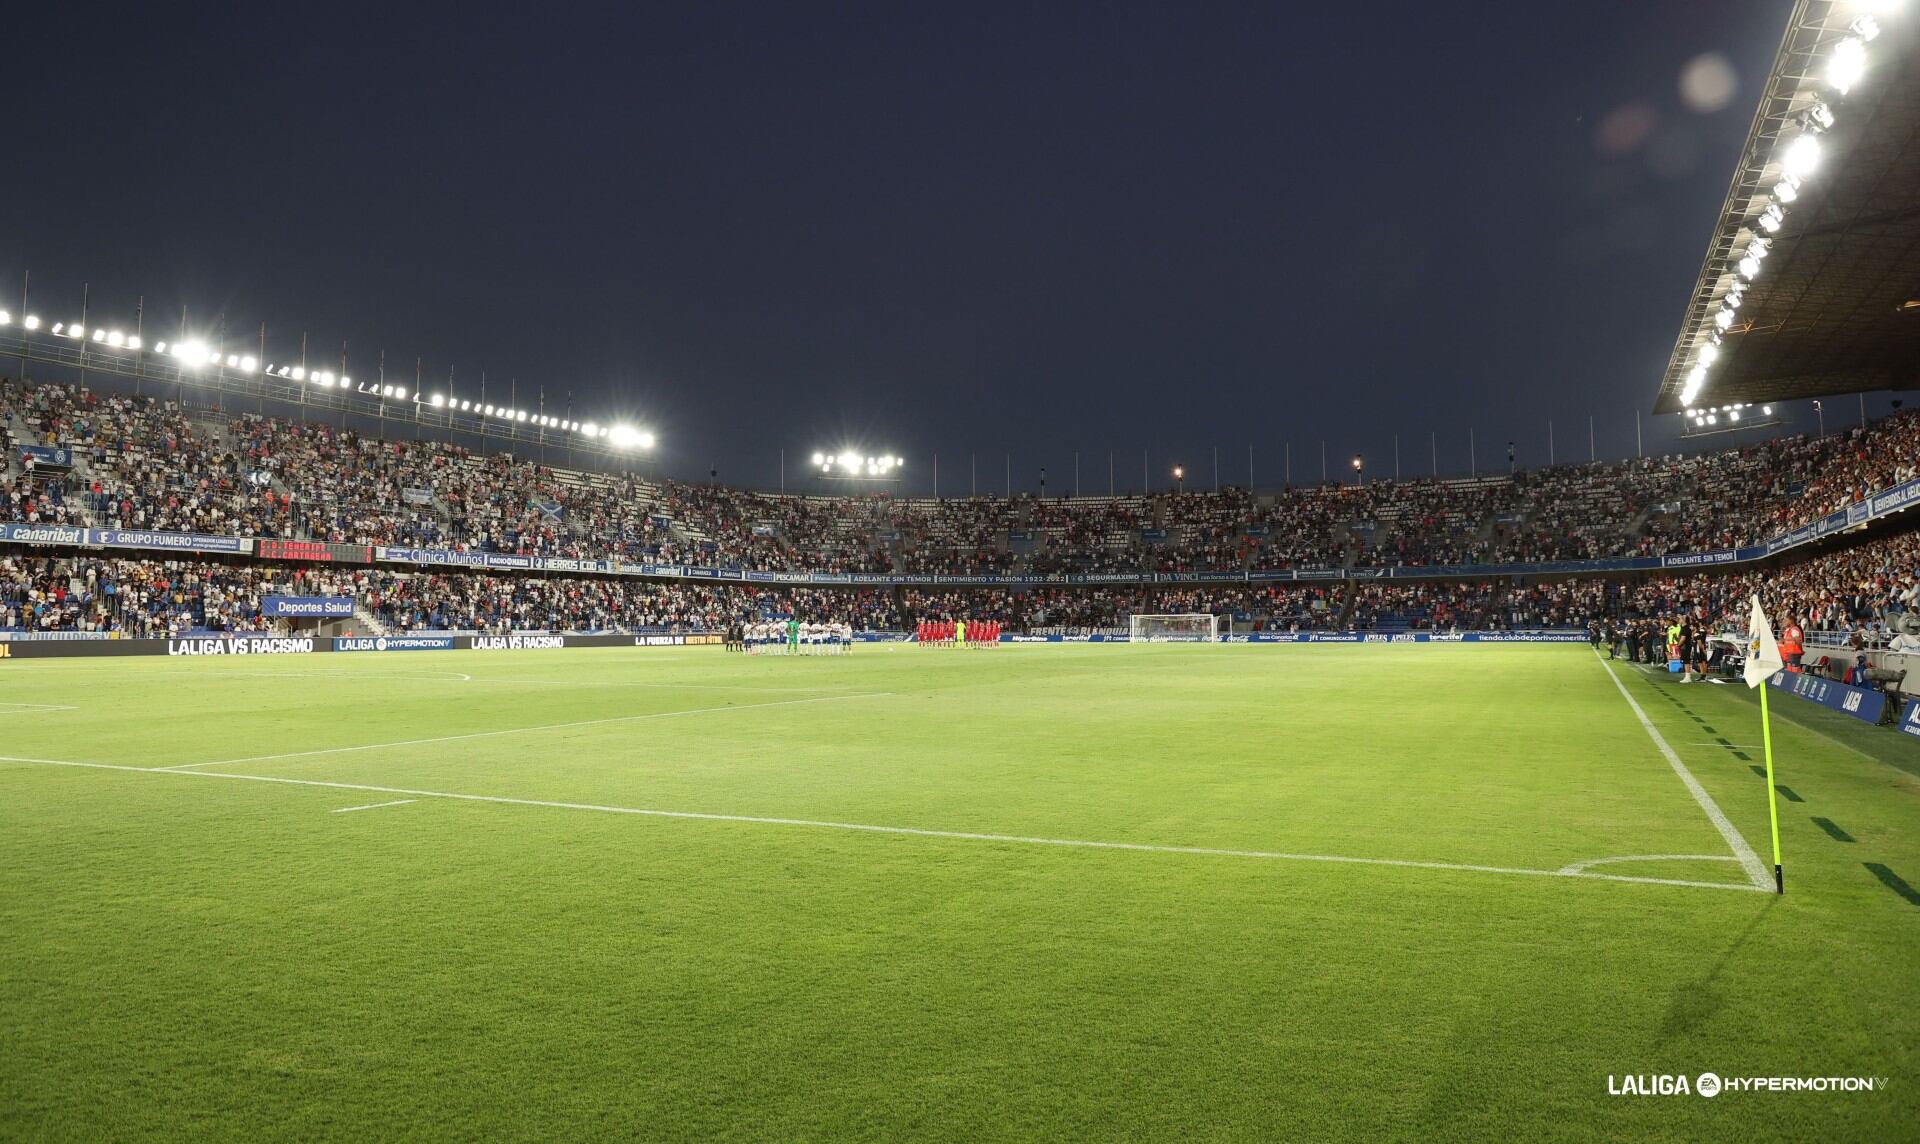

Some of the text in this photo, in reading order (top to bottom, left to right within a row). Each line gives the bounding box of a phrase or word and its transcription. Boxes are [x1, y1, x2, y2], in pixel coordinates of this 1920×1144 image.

[13, 528, 80, 543] canaribat
[117, 533, 192, 546] GRUPO FUMERO
[411, 549, 482, 565] Clínica Muiños
[1667, 553, 1733, 566] ADELANTE SIN TEMOR
[544, 558, 578, 570] HIERROS
[580, 560, 597, 571] ICOD
[619, 563, 642, 573] anaribat
[776, 573, 809, 581] PESCAMAR
[1174, 573, 1199, 581] VINCI
[278, 601, 351, 614] Deportes Salud
[1030, 626, 1066, 635] FRENTE
[169, 638, 313, 655] LALIGA VS RACISMO
[339, 638, 374, 650] LALIGA
[471, 636, 564, 649] LALIGA VS RACISMO
[635, 636, 645, 645] LA
[646, 636, 673, 645] FUERZA
[675, 636, 684, 645] DE
